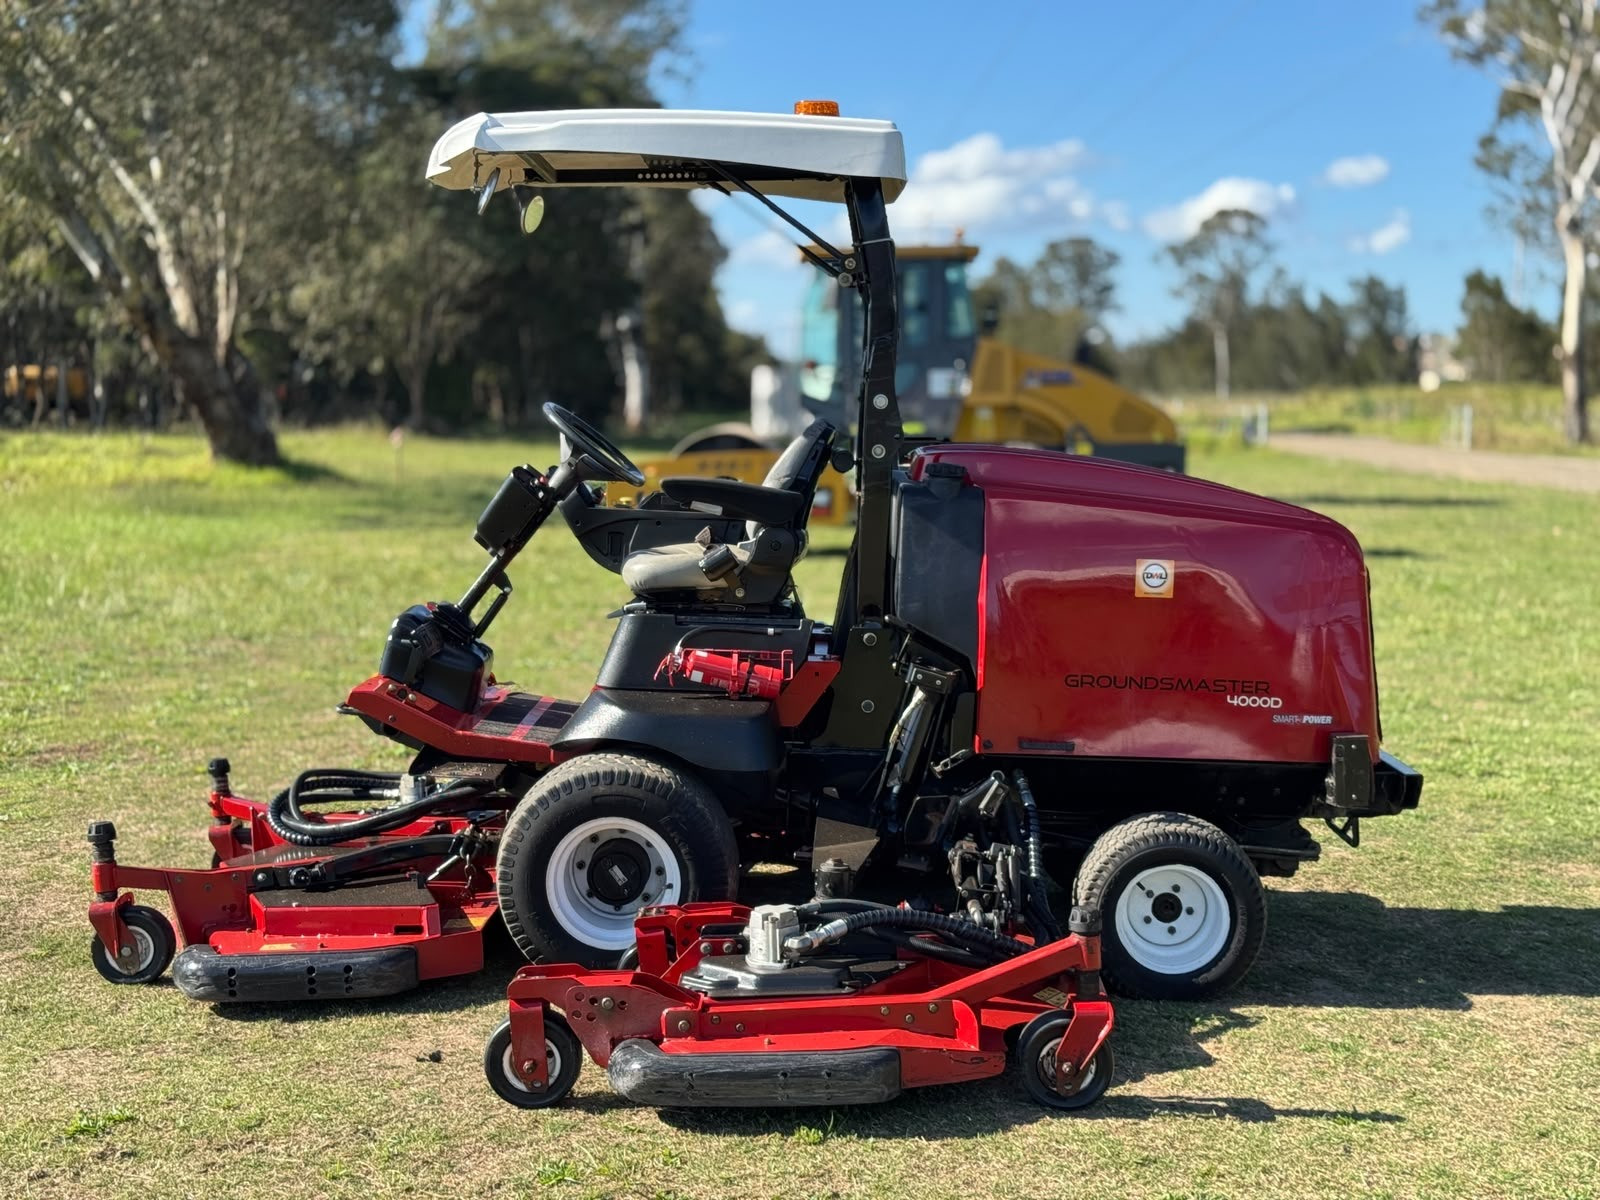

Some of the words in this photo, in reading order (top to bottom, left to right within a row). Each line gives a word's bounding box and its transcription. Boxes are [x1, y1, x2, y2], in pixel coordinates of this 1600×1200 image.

[1064, 674, 1270, 694] GROUNDSMASTER
[1226, 695, 1283, 709] 4000D
[1302, 715, 1333, 724] POWER
